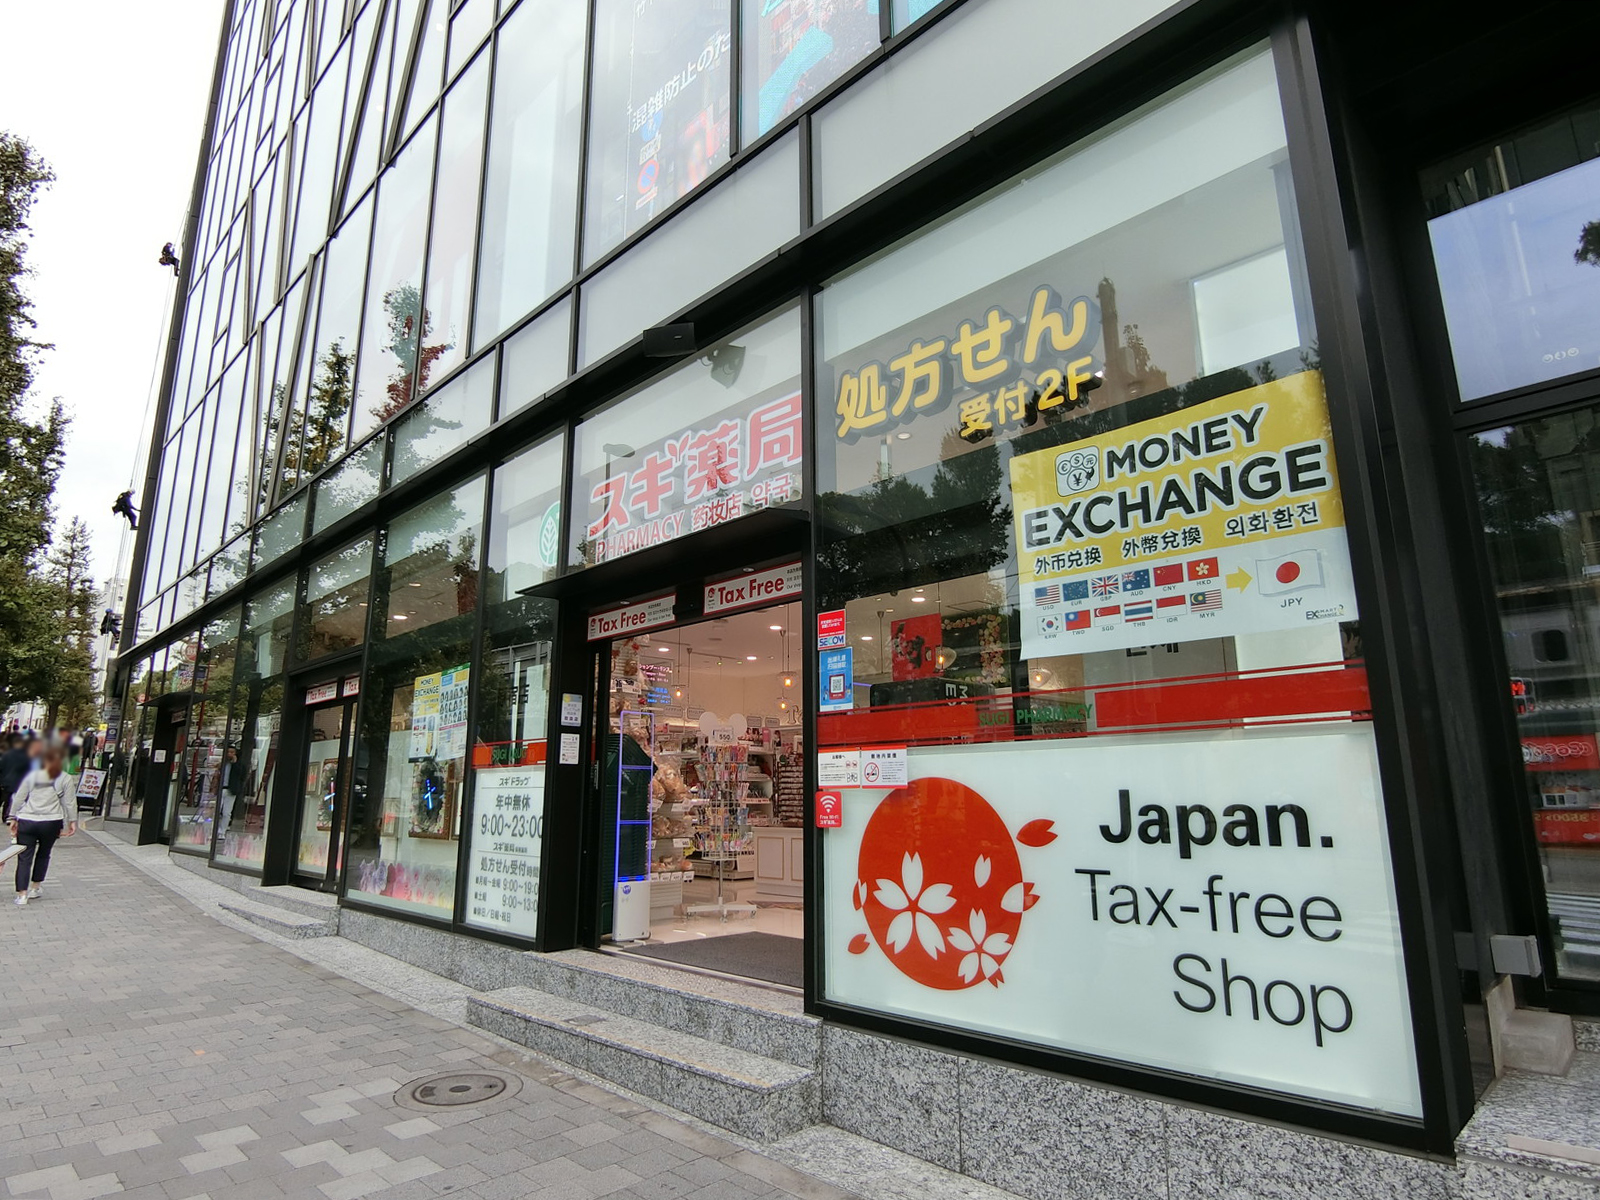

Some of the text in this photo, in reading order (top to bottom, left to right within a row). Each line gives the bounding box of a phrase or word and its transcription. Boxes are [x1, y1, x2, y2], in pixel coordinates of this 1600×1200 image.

[837, 288, 1088, 438] 処方せん
[959, 355, 1093, 438] 受付 2F
[1106, 406, 1265, 478] MONEY
[588, 392, 801, 538] スギ薬局
[752, 473, 792, 507] 약국
[1025, 444, 1327, 549] EXCHANGE
[692, 493, 742, 530] 药妆店
[1225, 501, 1319, 537] 외화환전
[596, 511, 685, 564] PHARMACY
[1034, 547, 1102, 574] 外币兑换
[718, 577, 784, 605] Tax Free
[1280, 597, 1303, 609] JPY
[598, 617, 619, 634] Tax
[620, 611, 646, 629] Free
[819, 636, 845, 647] SECOM
[414, 685, 440, 698] EXCHANGE
[978, 703, 1093, 727] SUGI PHARMACY
[495, 793, 532, 812] 年中無休
[1098, 788, 1334, 860] Japan.
[1073, 867, 1342, 942] Tax-free
[1172, 952, 1353, 1048] Shop
